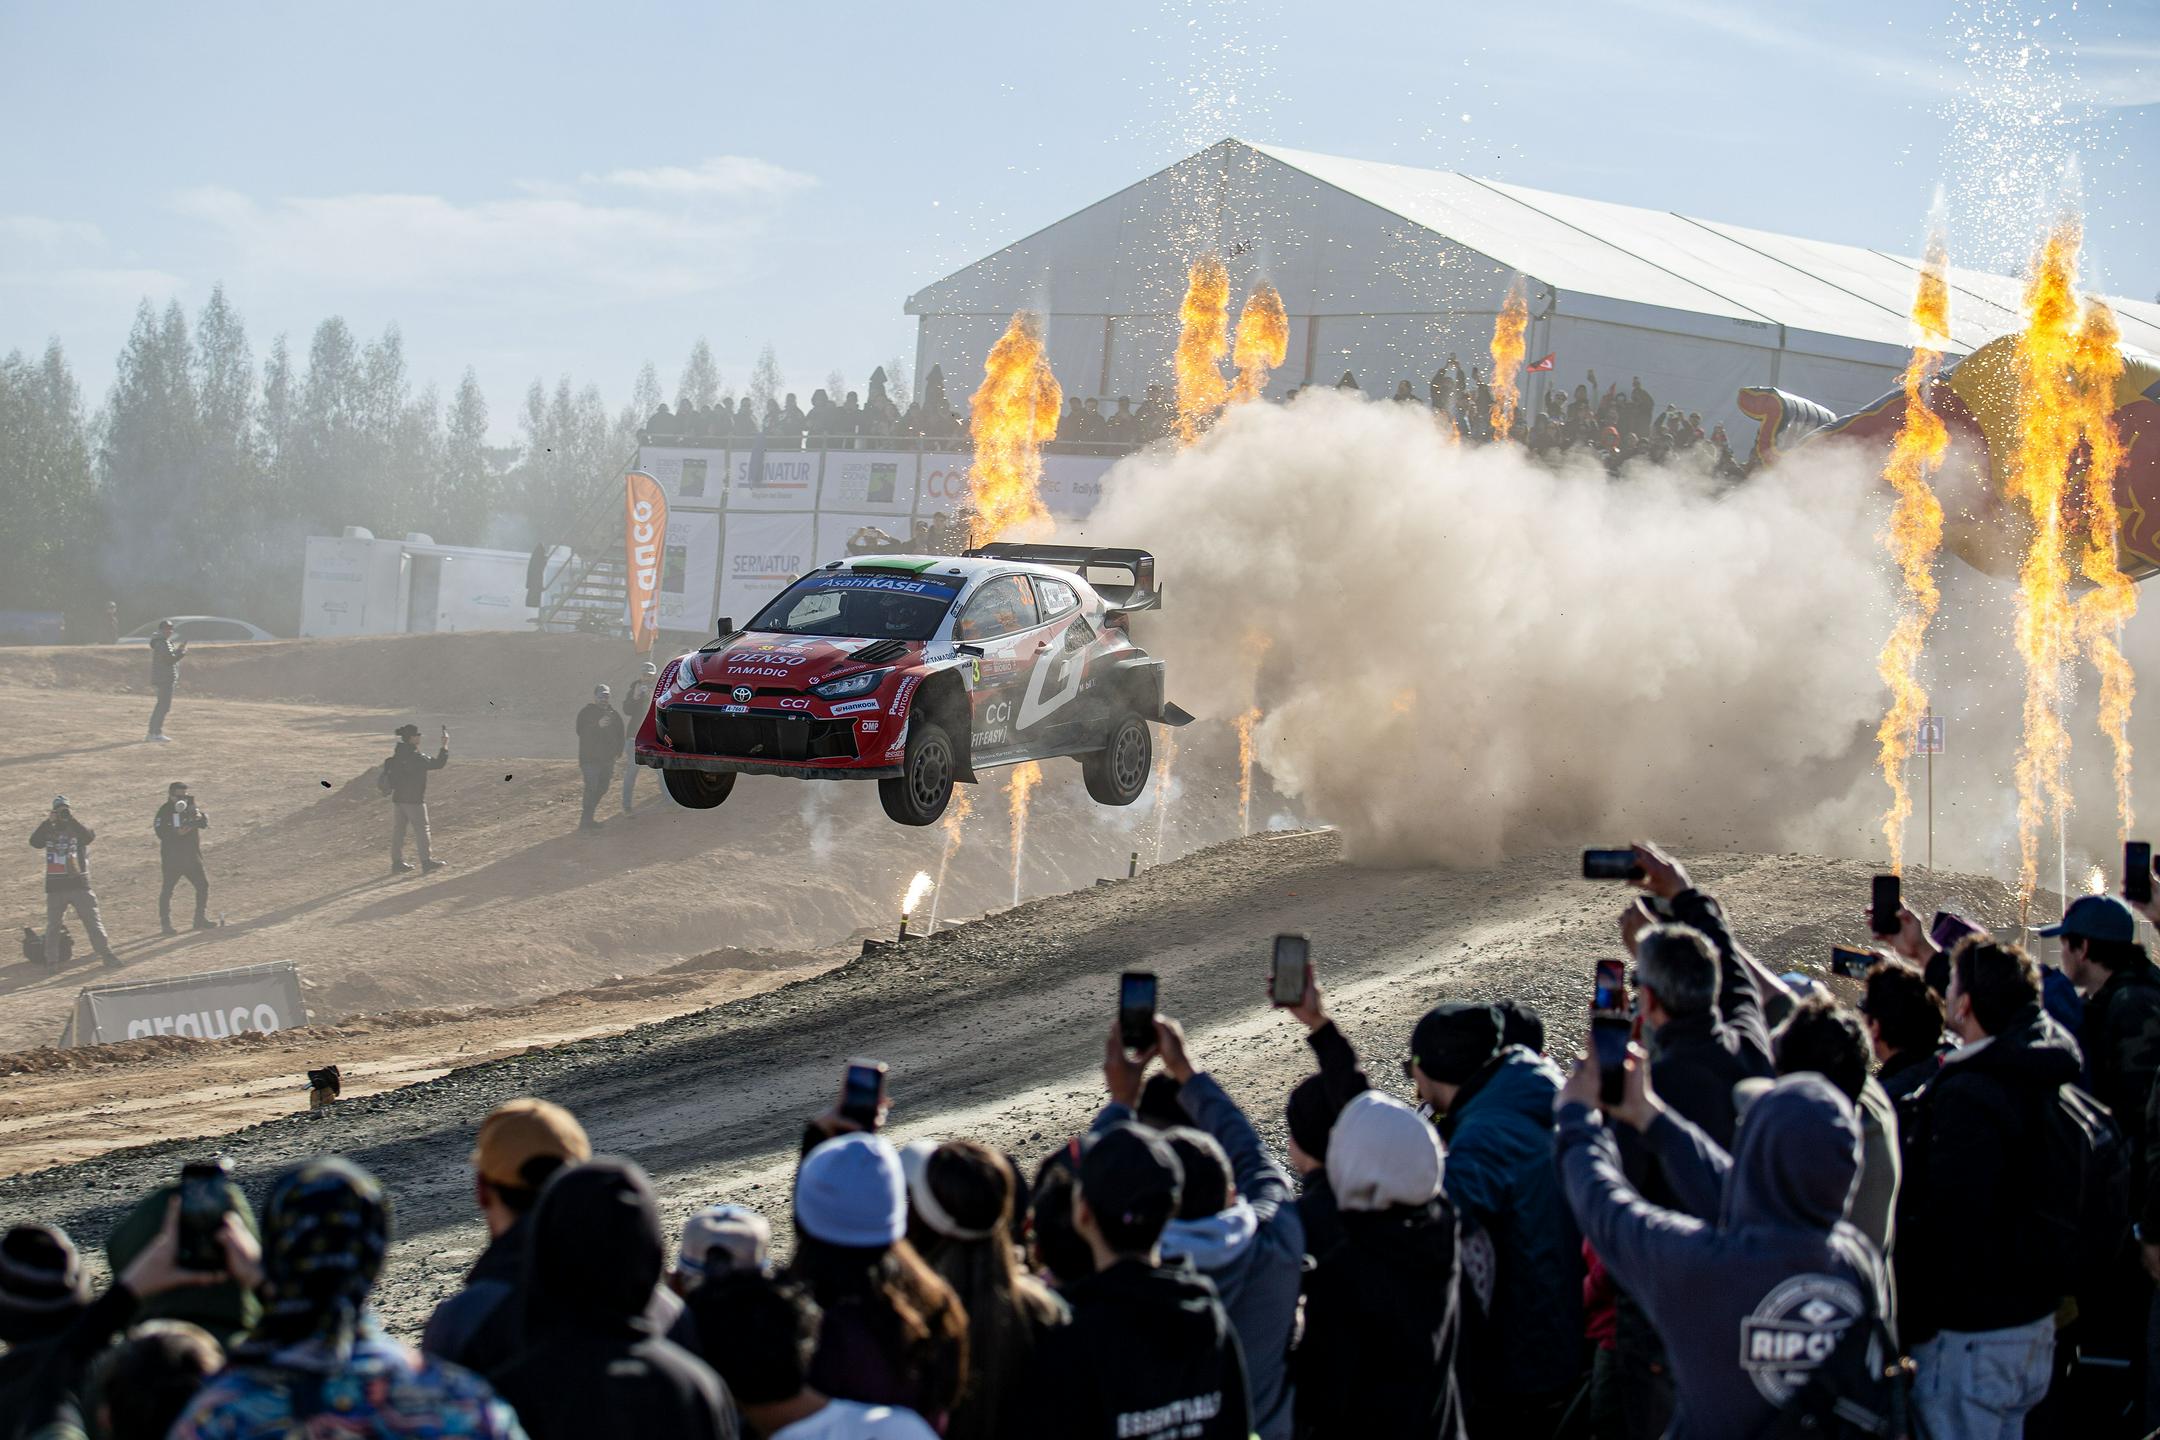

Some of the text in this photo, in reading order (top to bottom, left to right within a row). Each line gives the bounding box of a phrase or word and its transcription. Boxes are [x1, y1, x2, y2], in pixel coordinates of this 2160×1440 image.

[739, 462, 810, 481] SNATUR
[733, 554, 800, 573] SERNATUR
[1012, 575, 1036, 606] 33
[728, 653, 807, 666] DENSO
[727, 666, 788, 677] TAMADIC
[888, 675, 913, 716] Panasonic
[897, 676, 922, 718] AUTOMOTIVE
[861, 722, 880, 731] OMP
